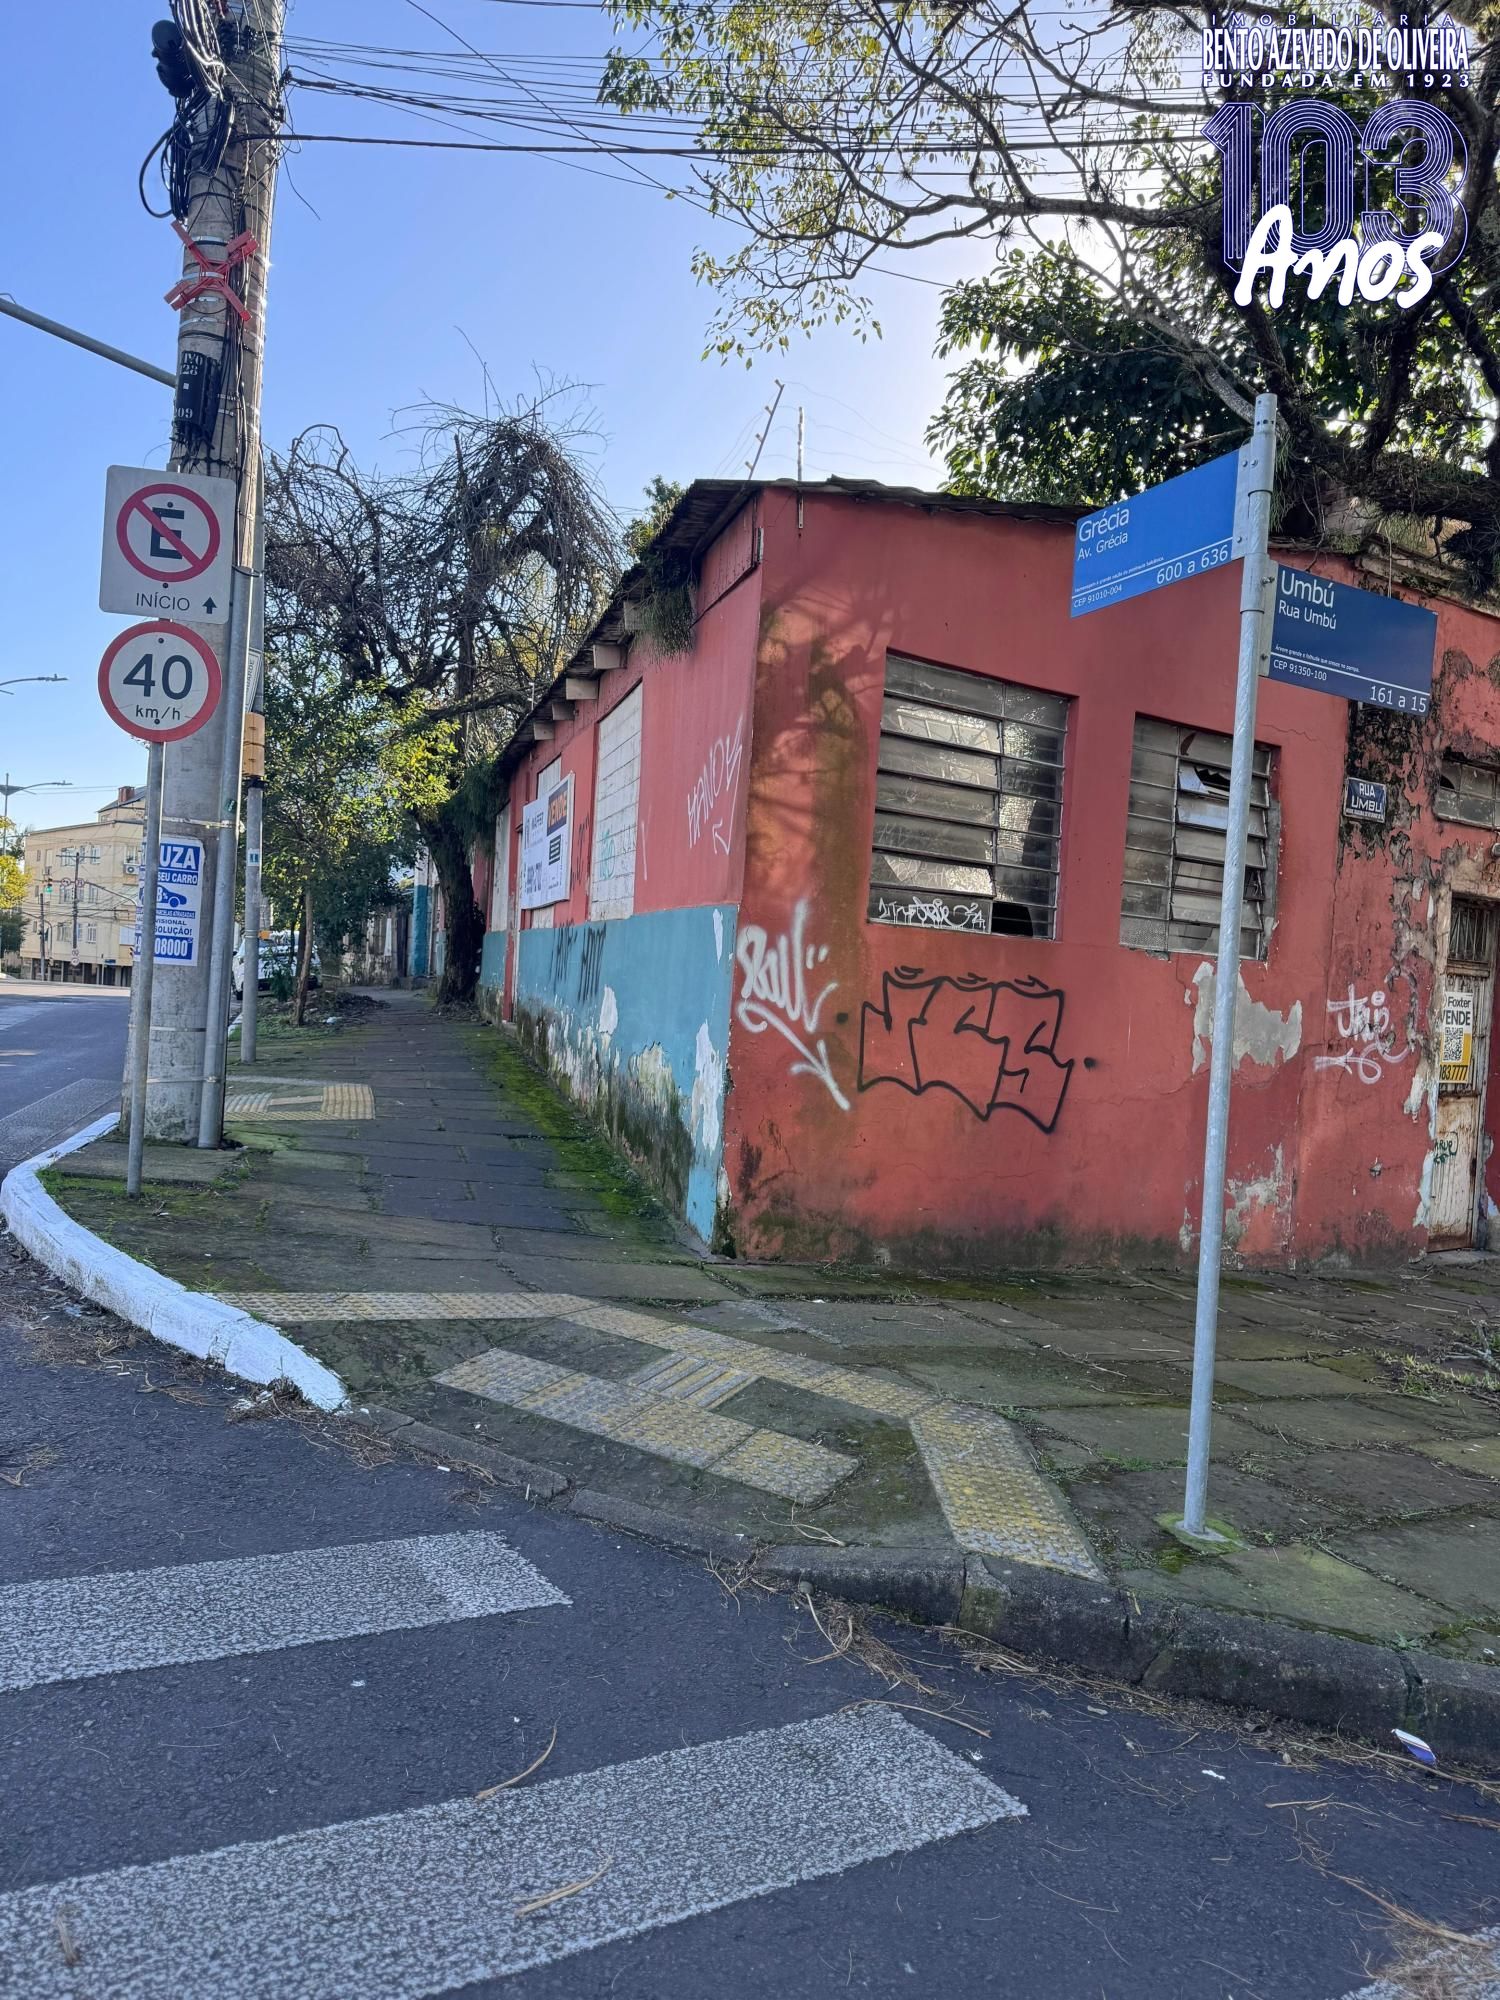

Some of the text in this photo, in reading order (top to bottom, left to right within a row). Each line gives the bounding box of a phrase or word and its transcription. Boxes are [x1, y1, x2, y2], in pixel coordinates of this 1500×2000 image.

[1078, 508, 1130, 542] Grécia
[1077, 532, 1128, 561] Av. Grécia
[1156, 562, 1182, 585] 600
[1187, 561, 1195, 574] a
[1201, 544, 1229, 569] 636
[1281, 570, 1335, 609] Umbú
[135, 591, 191, 612] INÍCIO
[1073, 597, 1086, 608] CEP
[1278, 600, 1337, 630] Rua Umbú
[123, 653, 193, 701] 40
[1273, 659, 1327, 681] CEP 91350-100
[1370, 685, 1427, 713] 161 a 15
[135, 704, 181, 721] km/h
[1359, 782, 1376, 798] RUA
[1351, 795, 1382, 813] UMBU
[171, 873, 198, 885] CARRO
[1447, 995, 1471, 1009] Foxter
[1441, 1009, 1471, 1026] VENDE
